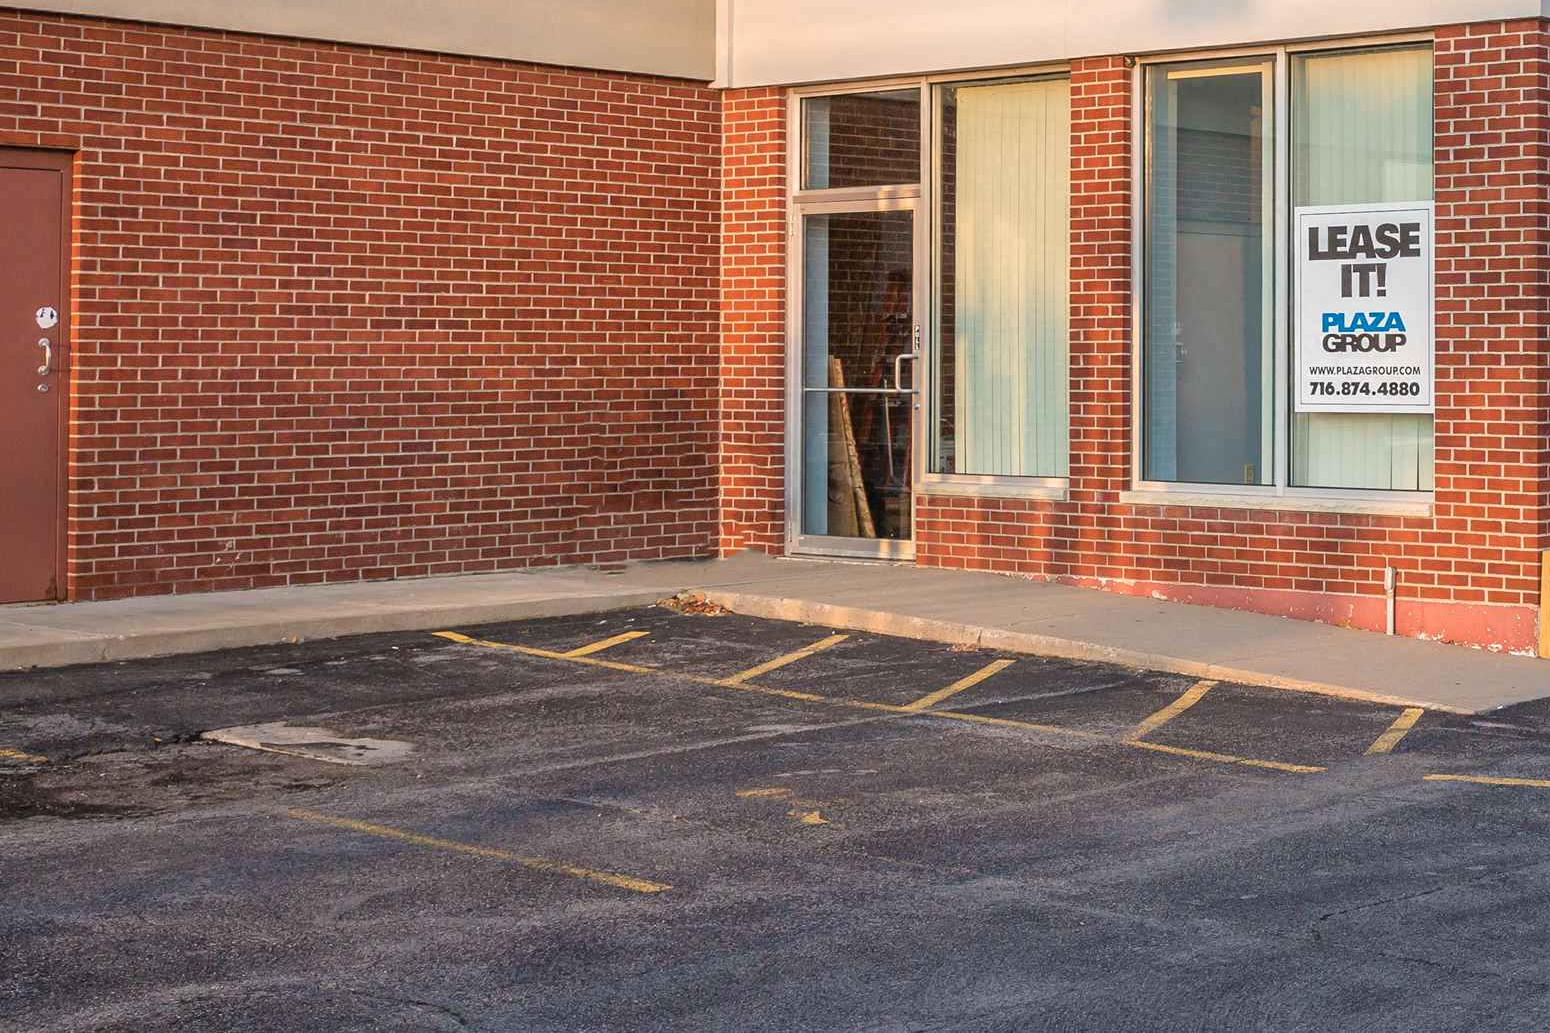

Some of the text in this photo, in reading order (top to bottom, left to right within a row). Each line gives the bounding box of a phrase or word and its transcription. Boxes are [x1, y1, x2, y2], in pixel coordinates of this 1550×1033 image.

[1308, 222, 1421, 261] LEASE
[1341, 263, 1387, 298] IT!
[1322, 312, 1406, 333] PLAZA
[1322, 333, 1407, 353] GROUP
[1309, 366, 1421, 376] WWW.PLAZAGROUP.COM
[1310, 382, 1420, 396] 716.874.4880
